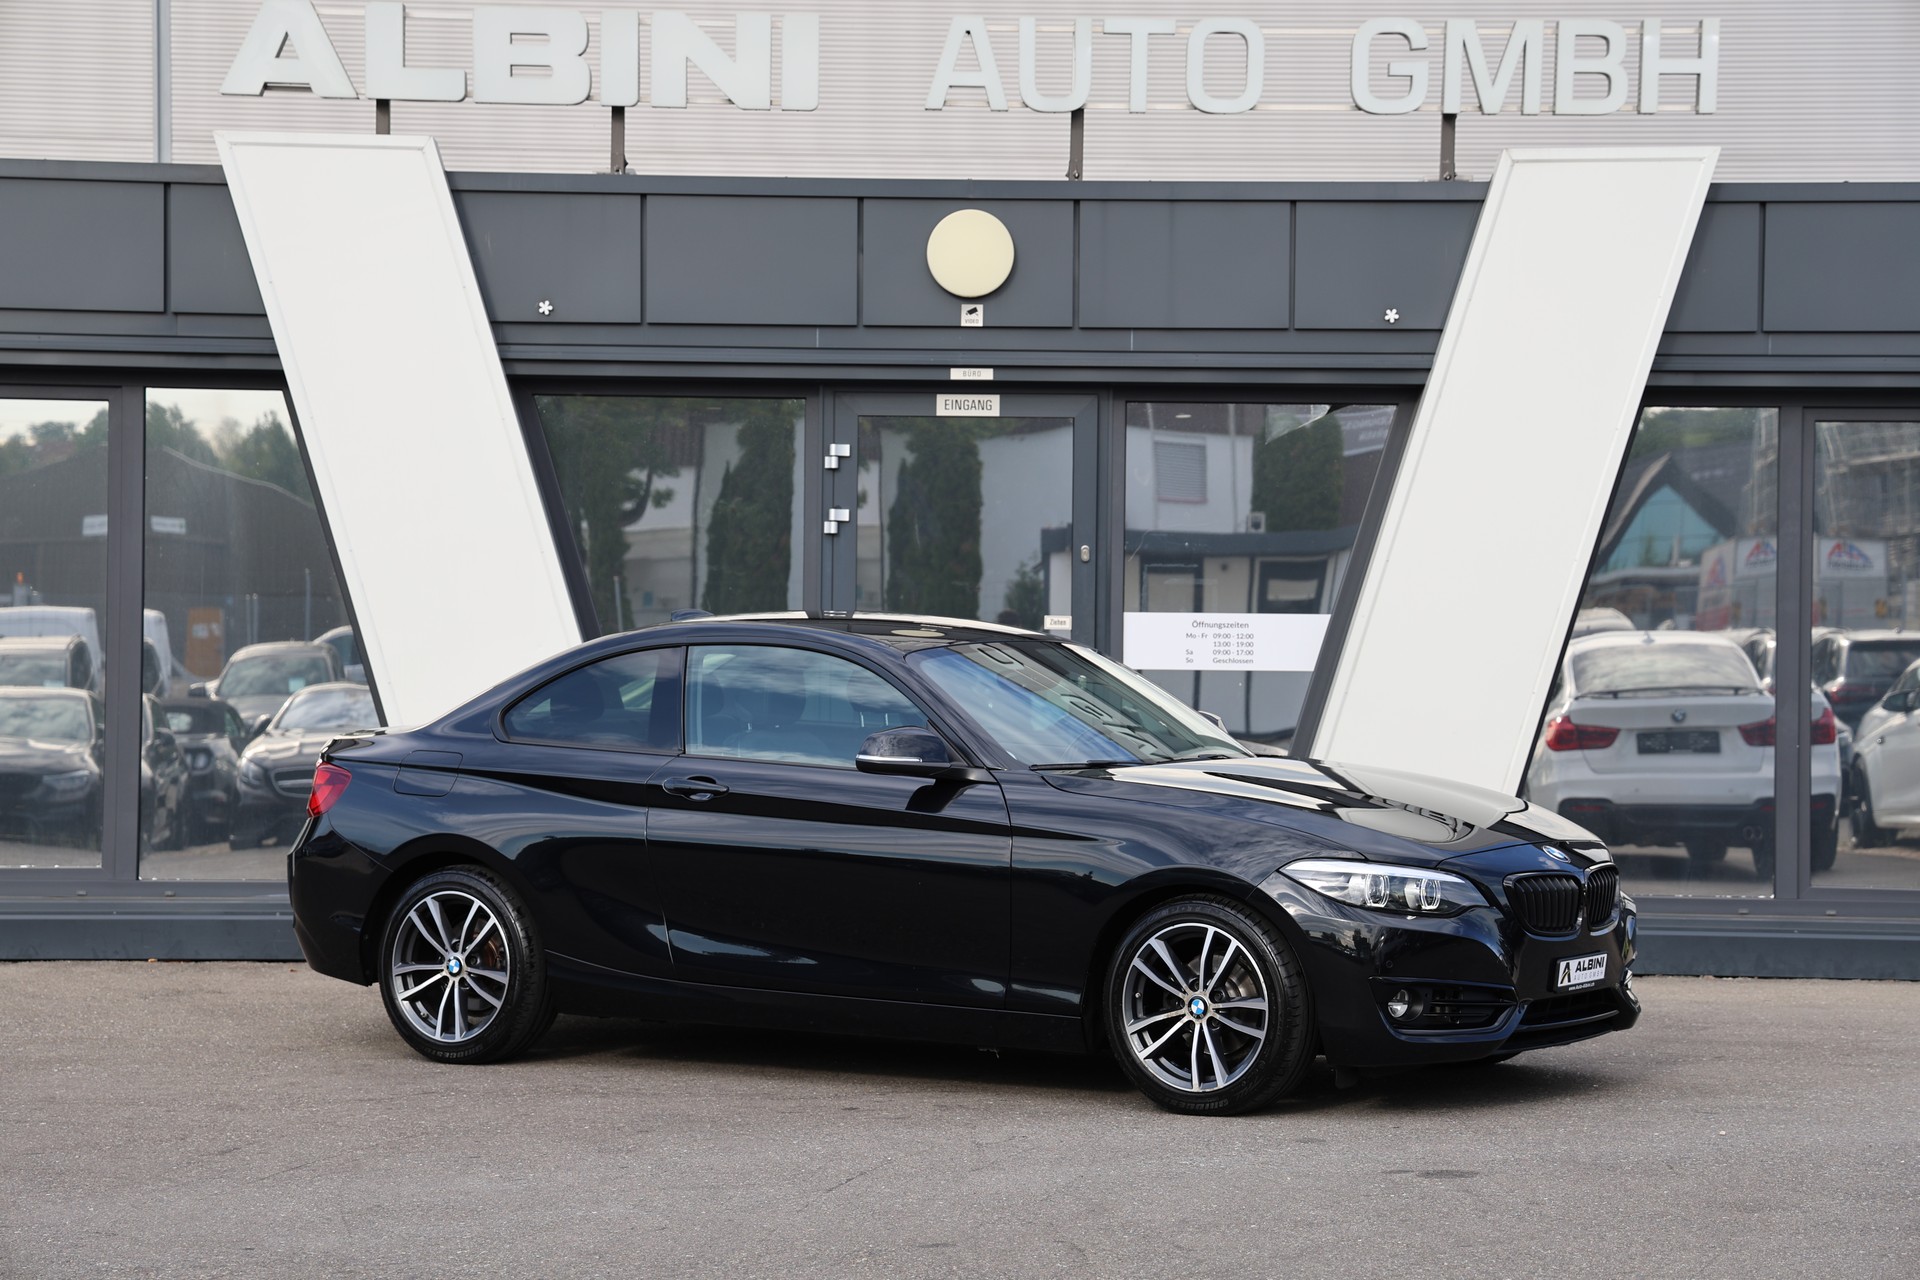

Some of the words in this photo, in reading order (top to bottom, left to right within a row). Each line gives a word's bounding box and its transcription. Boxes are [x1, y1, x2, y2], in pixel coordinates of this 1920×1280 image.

[220, 0, 820, 111] ALBINI
[925, 17, 1264, 114] AUTO
[1351, 17, 1721, 116] GMBH
[962, 368, 982, 377] BÜRO
[944, 399, 993, 411] EINGANG
[1191, 620, 1250, 630] Öffnungszeiten
[1212, 632, 1232, 640] 09:00
[1236, 632, 1255, 640] 12:00
[1575, 956, 1605, 972] ALBINI
